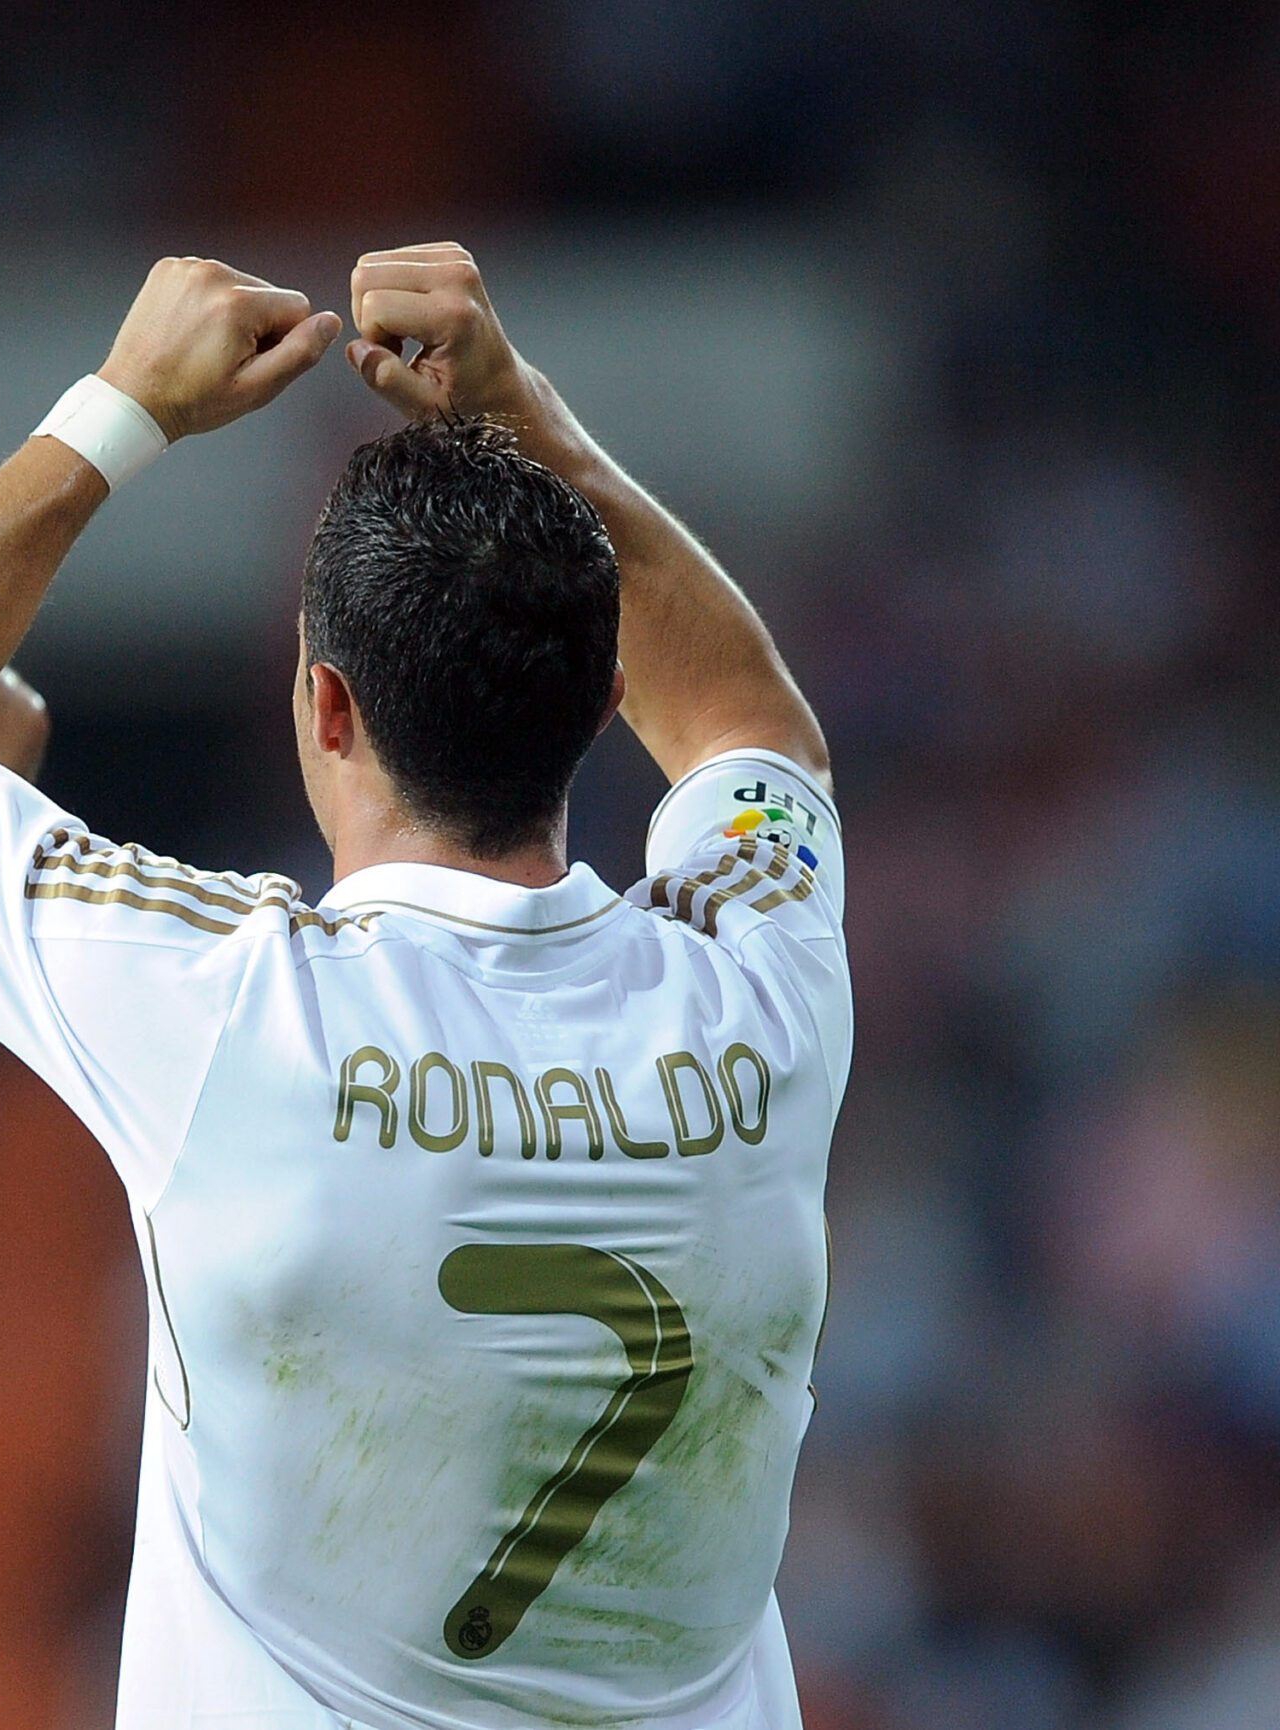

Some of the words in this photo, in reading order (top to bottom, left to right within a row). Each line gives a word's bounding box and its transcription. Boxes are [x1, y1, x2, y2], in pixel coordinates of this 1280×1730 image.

[733, 780, 817, 837] LFP
[332, 1042, 771, 1161] RONALDO
[438, 1243, 694, 1661] 7
